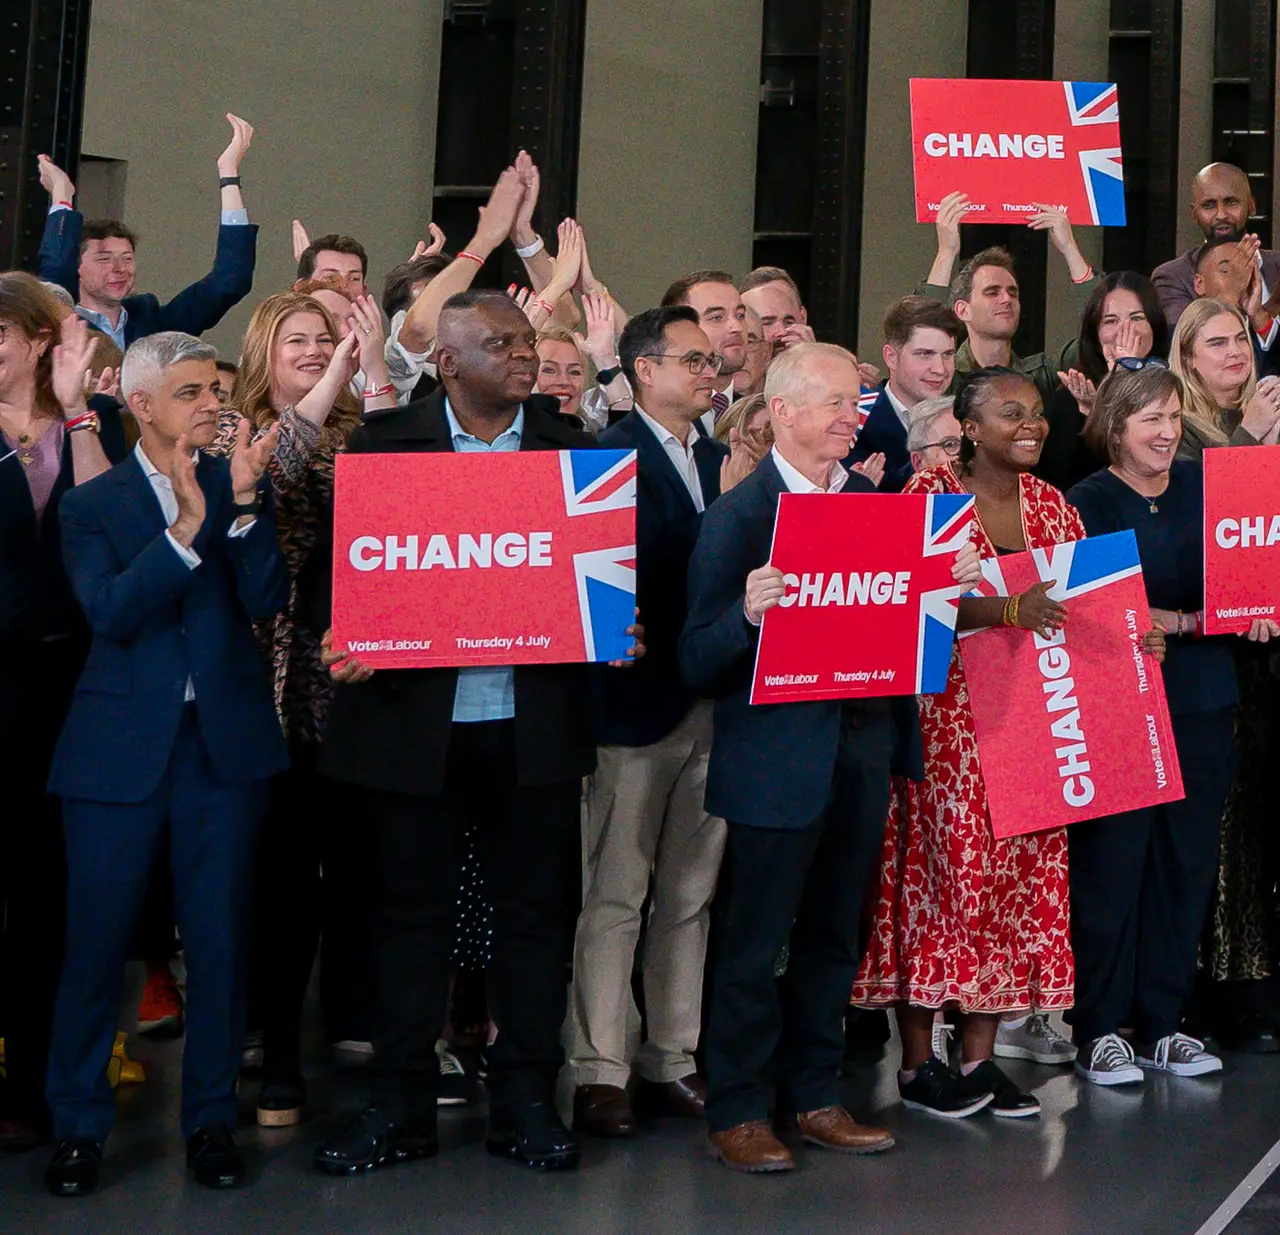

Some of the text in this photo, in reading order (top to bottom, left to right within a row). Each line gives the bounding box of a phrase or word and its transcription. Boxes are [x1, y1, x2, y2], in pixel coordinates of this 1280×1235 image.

[923, 132, 1065, 159] CHANGE
[348, 531, 553, 572] CHANGE
[778, 571, 911, 608] CHANGE
[1124, 608, 1137, 632] July
[1215, 605, 1276, 619] Vote Labour
[347, 639, 432, 652] Vote Labour
[455, 634, 551, 651] Thursday 4 July
[1128, 632, 1138, 640] 4
[764, 673, 820, 687] Vote Labour
[833, 668, 896, 684] Thursday 4 July
[1032, 626, 1096, 808] CHANGE
[1145, 714, 1167, 789] Vote Labour
